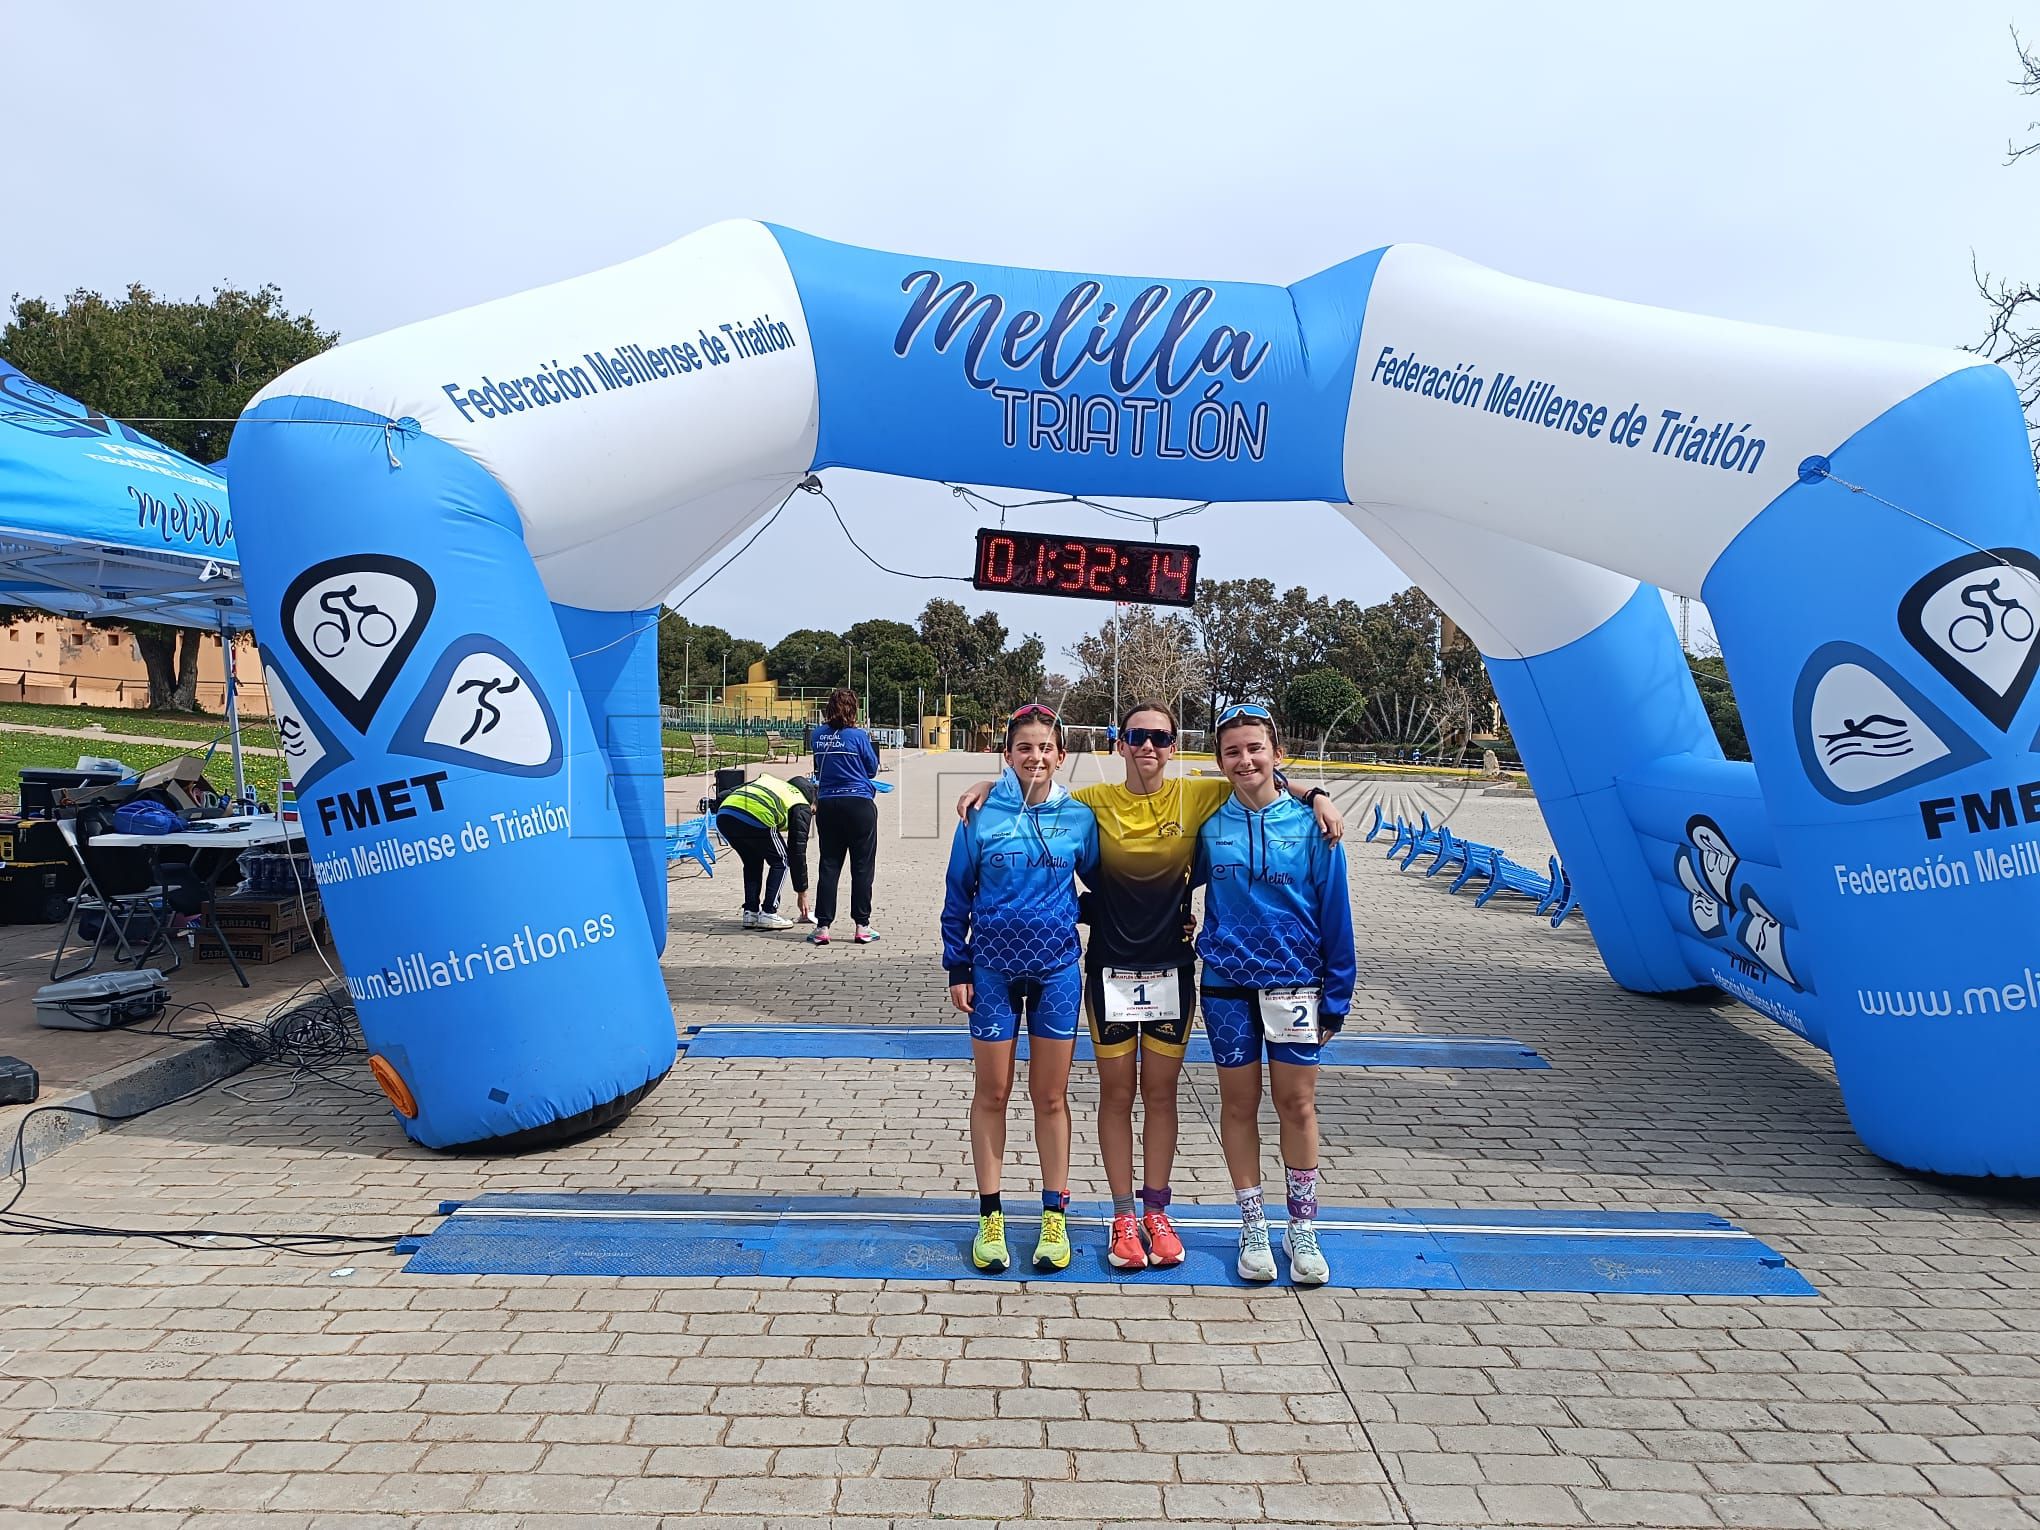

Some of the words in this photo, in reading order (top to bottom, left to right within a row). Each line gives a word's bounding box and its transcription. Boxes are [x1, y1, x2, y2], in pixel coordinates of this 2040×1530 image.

[894, 269, 1271, 396] Melilla
[441, 360, 598, 423] Federación
[583, 343, 702, 391] Melillense
[699, 330, 730, 366] de
[719, 314, 796, 359] Triatlón
[992, 380, 1269, 461] TRIATLÓN
[1371, 346, 1483, 408] Federación
[1483, 372, 1608, 439] Melillense
[1609, 403, 1647, 448] de
[1652, 409, 1766, 474] Triatlón
[986, 536, 1192, 598] 01:32:14
[316, 770, 449, 836] FMET
[351, 832, 456, 878] Melillense
[460, 821, 490, 852] de
[490, 801, 570, 845] Triatlón
[990, 852, 1023, 868] CT
[1212, 864, 1244, 880] CT
[1833, 854, 1970, 896] Federación
[1133, 984, 1151, 1005] 1
[1292, 1005, 1310, 1027] 2
